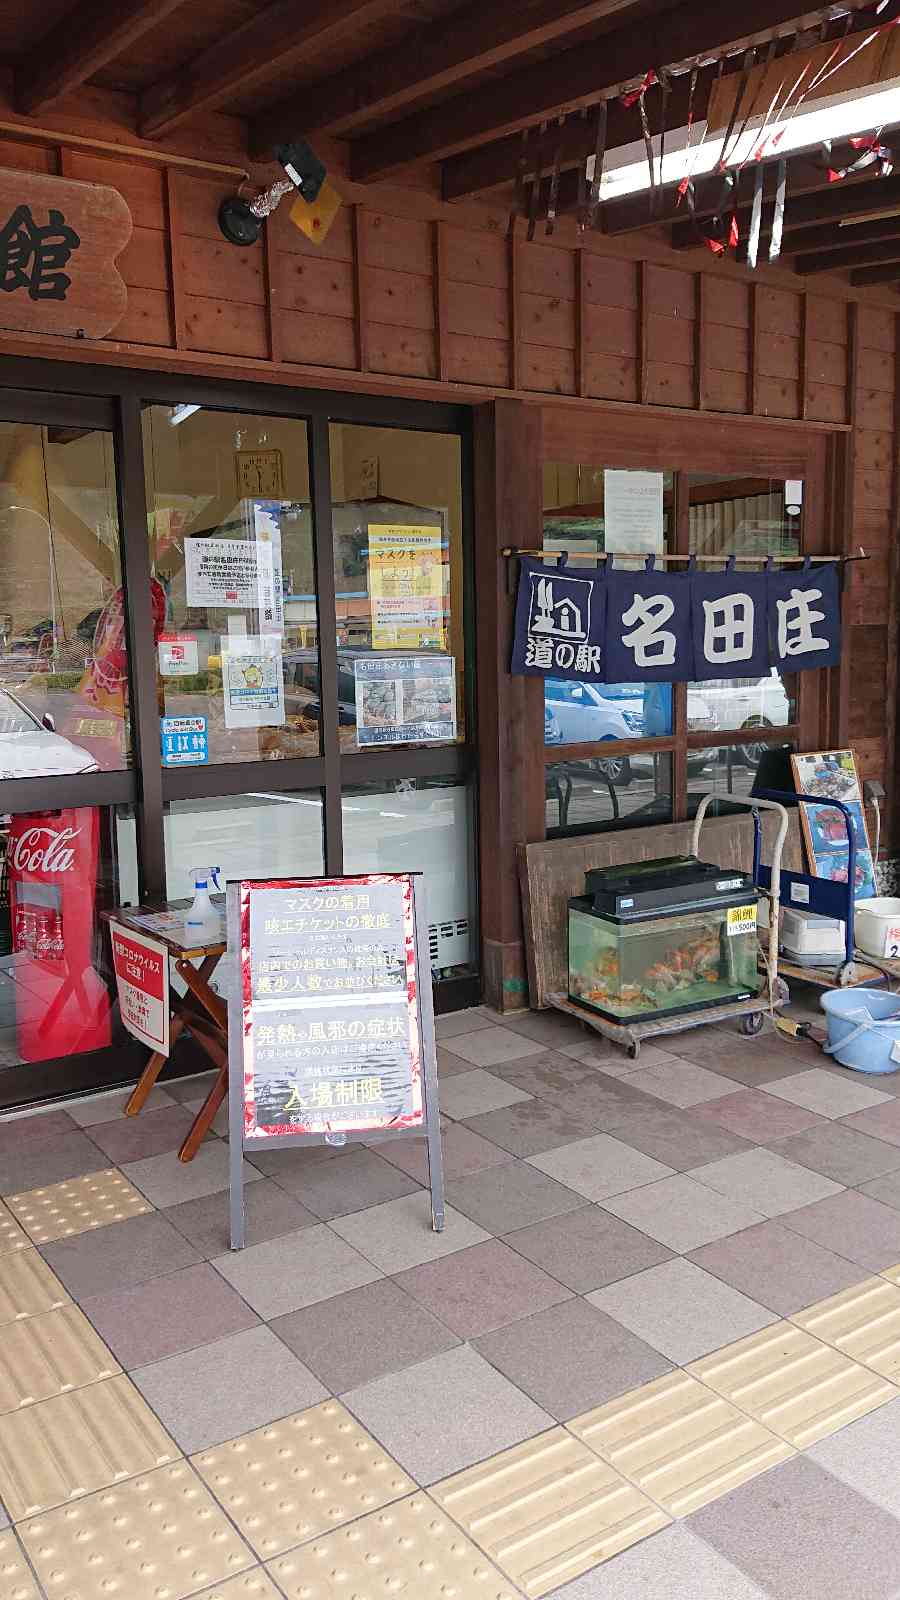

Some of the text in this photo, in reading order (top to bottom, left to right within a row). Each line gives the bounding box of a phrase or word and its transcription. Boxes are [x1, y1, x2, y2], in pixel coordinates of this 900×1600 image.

[0, 205, 80, 301] 館
[621, 589, 830, 667] 名田庄
[525, 638, 601, 673] 道の駅
[14, 827, 81, 872] Cola
[286, 895, 369, 912] マスクの着用
[264, 913, 391, 933] 咳エチケットの徹底
[257, 1016, 405, 1046] 発熱や風邪の症状
[284, 1078, 384, 1110] 入場制限
